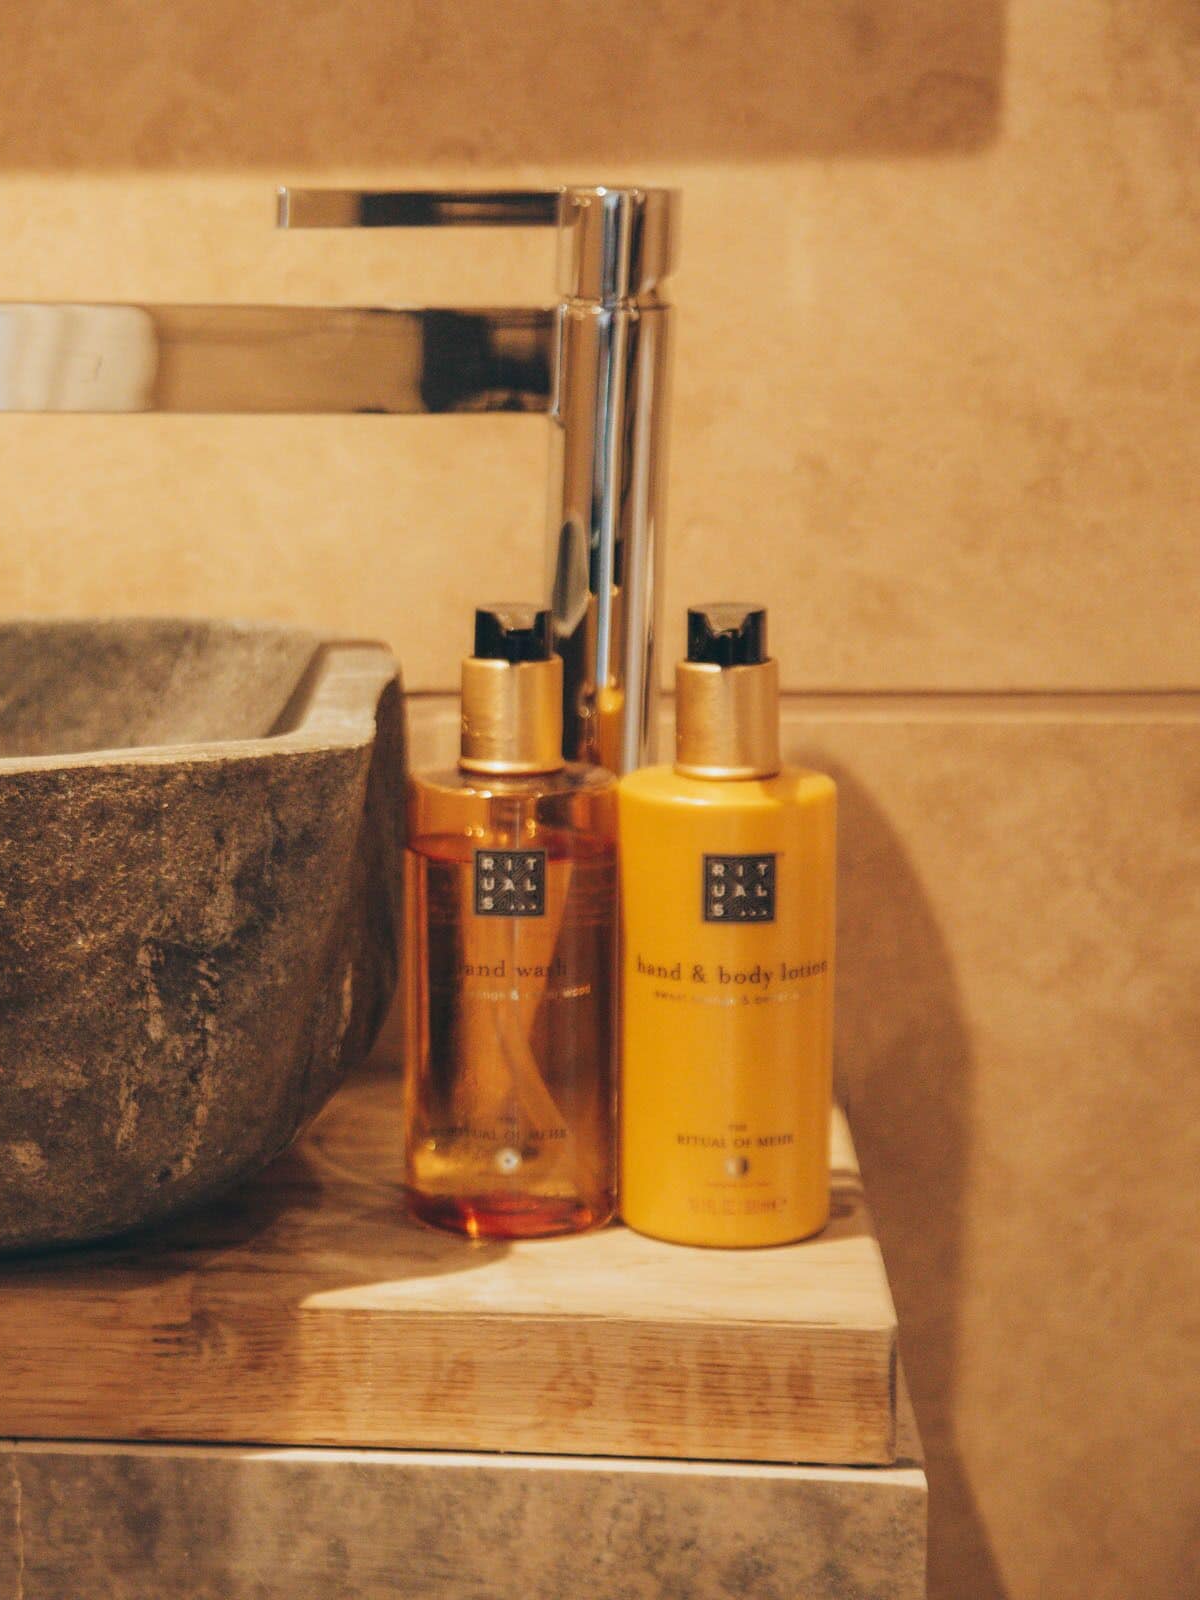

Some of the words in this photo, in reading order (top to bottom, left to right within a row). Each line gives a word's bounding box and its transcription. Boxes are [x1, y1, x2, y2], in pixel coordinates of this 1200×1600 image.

[458, 960, 506, 977] and
[636, 955, 682, 981] hand
[692, 964, 707, 983] &
[719, 961, 774, 989] body
